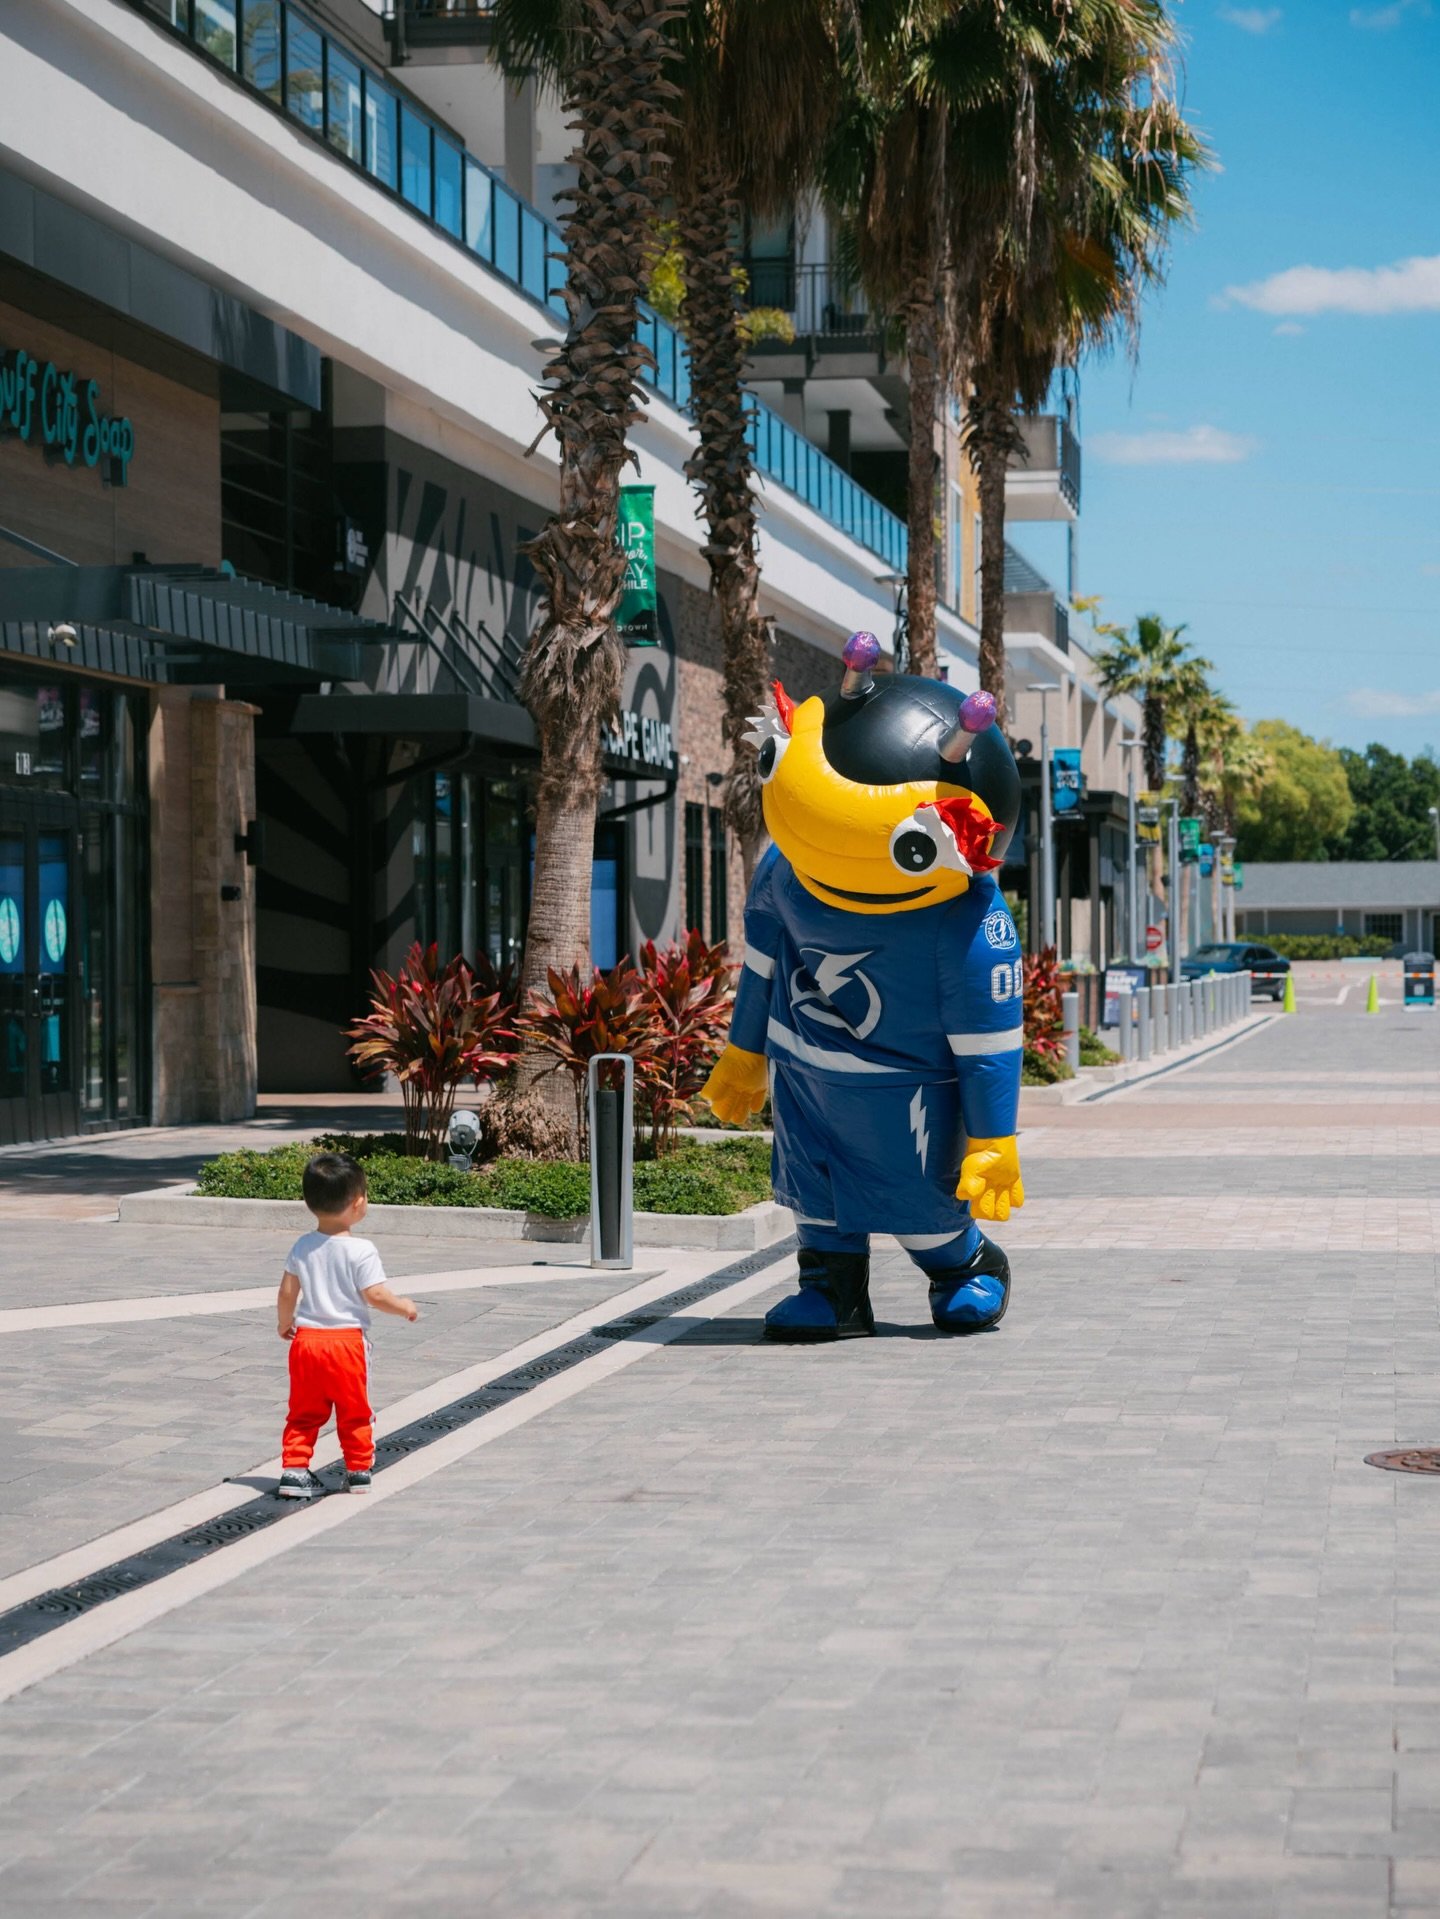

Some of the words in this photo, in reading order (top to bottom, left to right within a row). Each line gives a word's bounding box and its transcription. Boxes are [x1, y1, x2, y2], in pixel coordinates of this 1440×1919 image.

[0, 349, 38, 441] uff
[41, 361, 79, 465] City
[83, 378, 134, 488] Soap
[622, 578, 648, 590] HILE
[624, 562, 647, 579] AY
[641, 715, 674, 770] GAME
